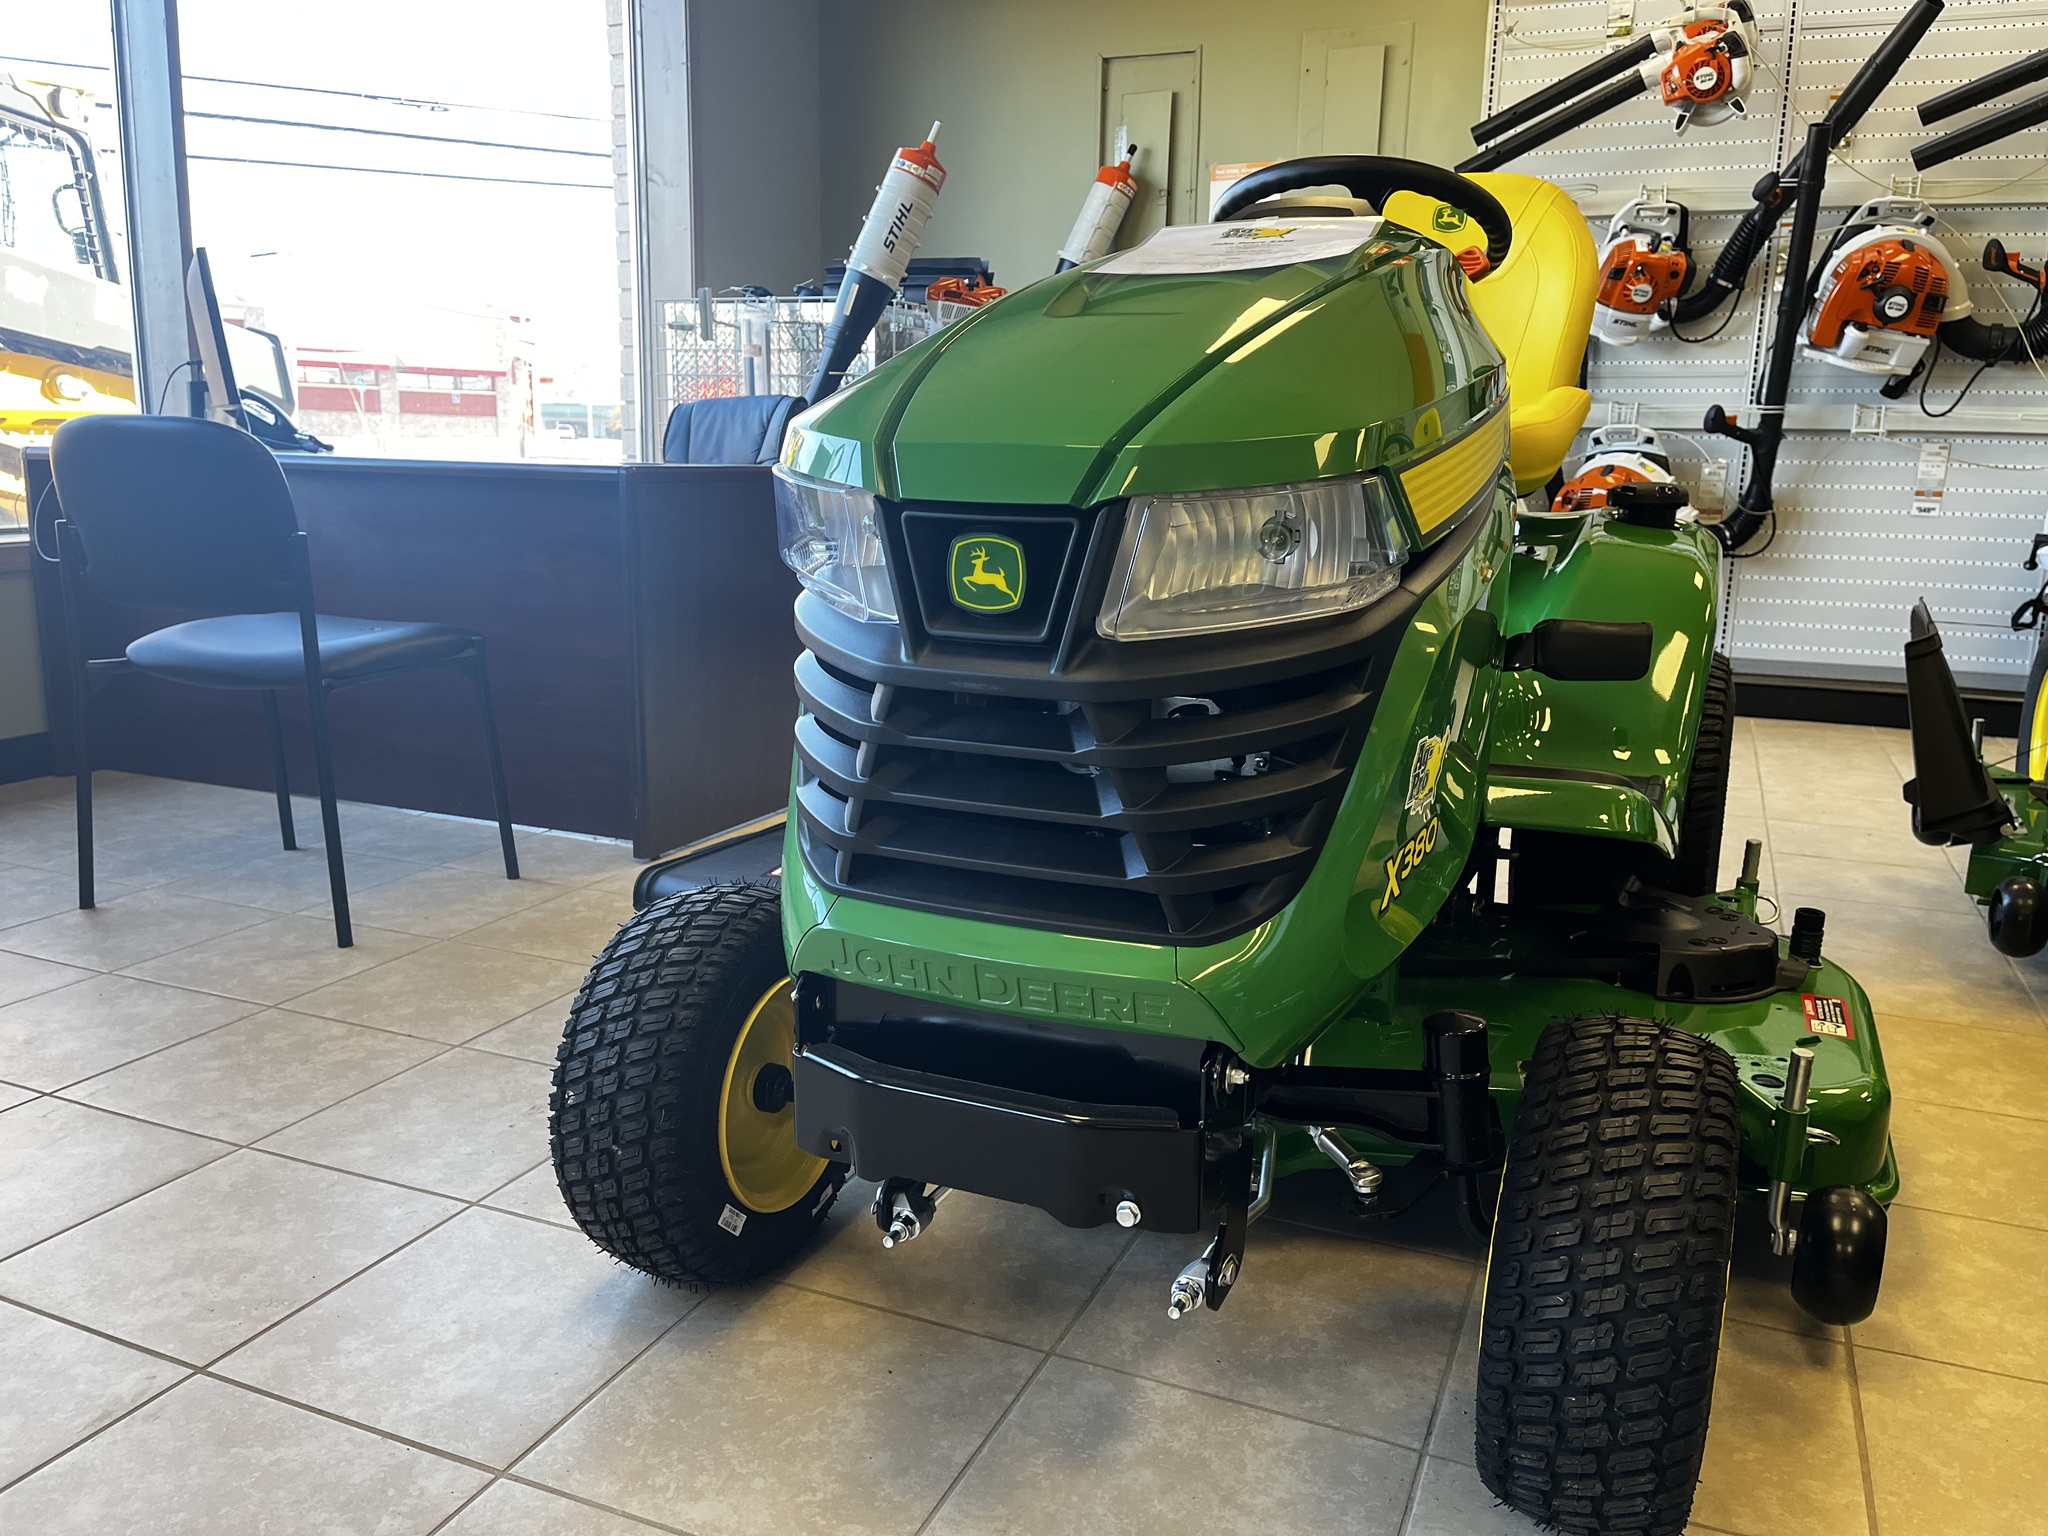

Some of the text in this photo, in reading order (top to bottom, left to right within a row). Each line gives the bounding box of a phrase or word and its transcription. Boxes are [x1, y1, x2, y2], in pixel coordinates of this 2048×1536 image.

[1694, 71, 1715, 82] STIHL
[883, 202, 914, 254] STIHL
[1612, 318, 1638, 328] STIHL
[1863, 344, 1894, 356] STIHL
[1380, 815, 1439, 912] X380
[831, 937, 1173, 1029] JOHN DEERE
